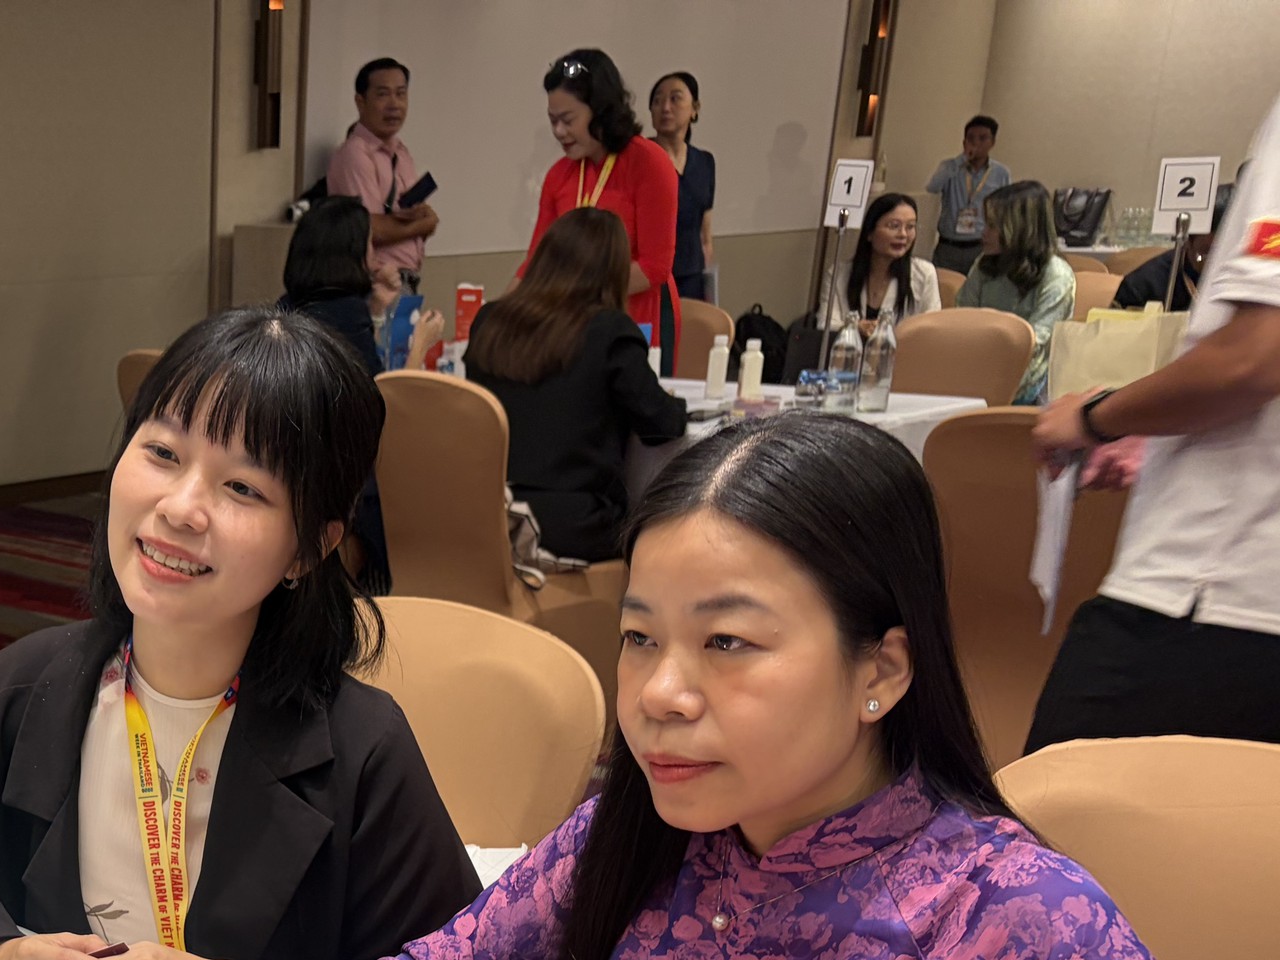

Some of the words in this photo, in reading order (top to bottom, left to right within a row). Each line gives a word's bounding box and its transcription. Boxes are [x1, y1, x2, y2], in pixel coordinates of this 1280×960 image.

[844, 176, 853, 194] 1
[1177, 176, 1196, 197] 2
[140, 733, 153, 787] VIETNAMESE
[143, 801, 160, 850] DISCOVER
[171, 800, 182, 850] DISCOVER
[150, 852, 161, 866] THE
[170, 851, 179, 866] THE
[152, 868, 168, 903] CHARM
[171, 867, 183, 901] CHARM
[159, 905, 168, 914] OF
